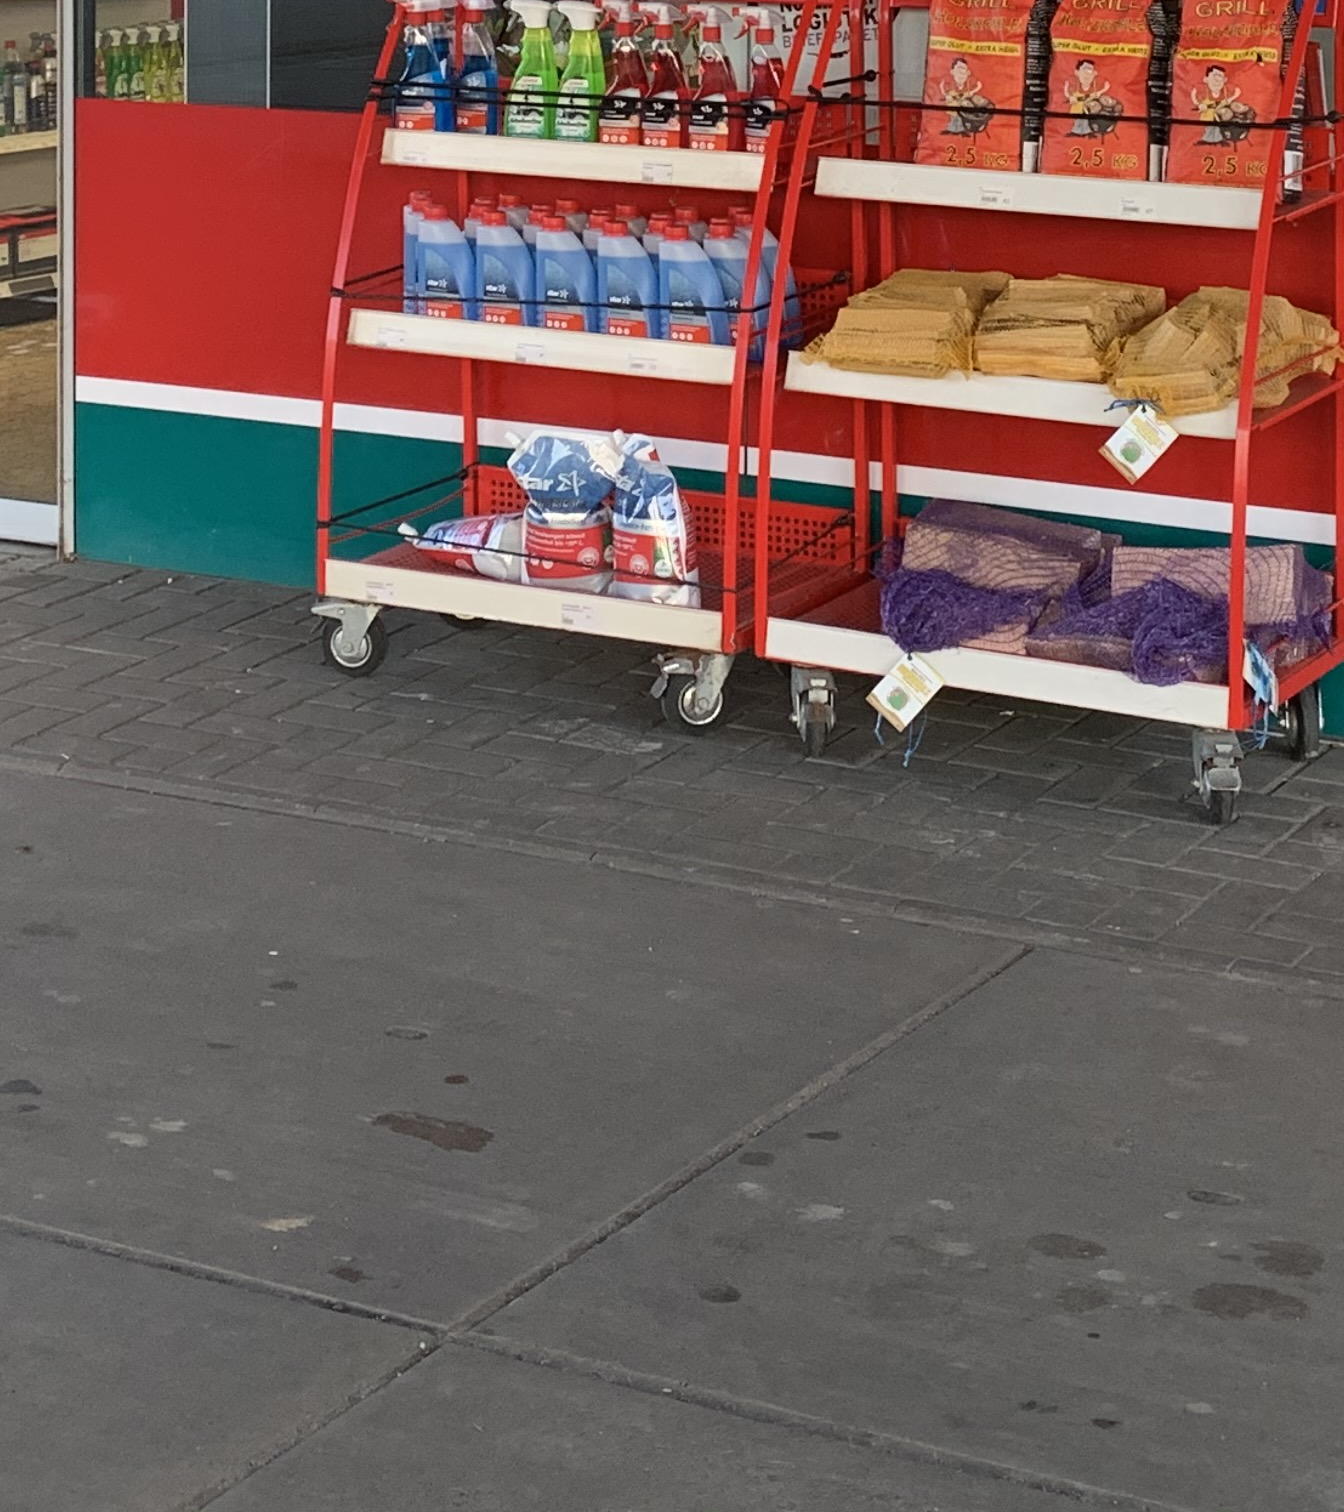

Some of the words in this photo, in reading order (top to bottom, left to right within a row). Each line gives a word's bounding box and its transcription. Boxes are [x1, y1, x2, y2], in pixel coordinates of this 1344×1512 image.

[1195, 0, 1270, 18] GRILL
[945, 145, 977, 166] 2,5
[1069, 147, 1104, 169] 2,5
[1111, 153, 1139, 170] KG
[1202, 155, 1238, 180] 2,5
